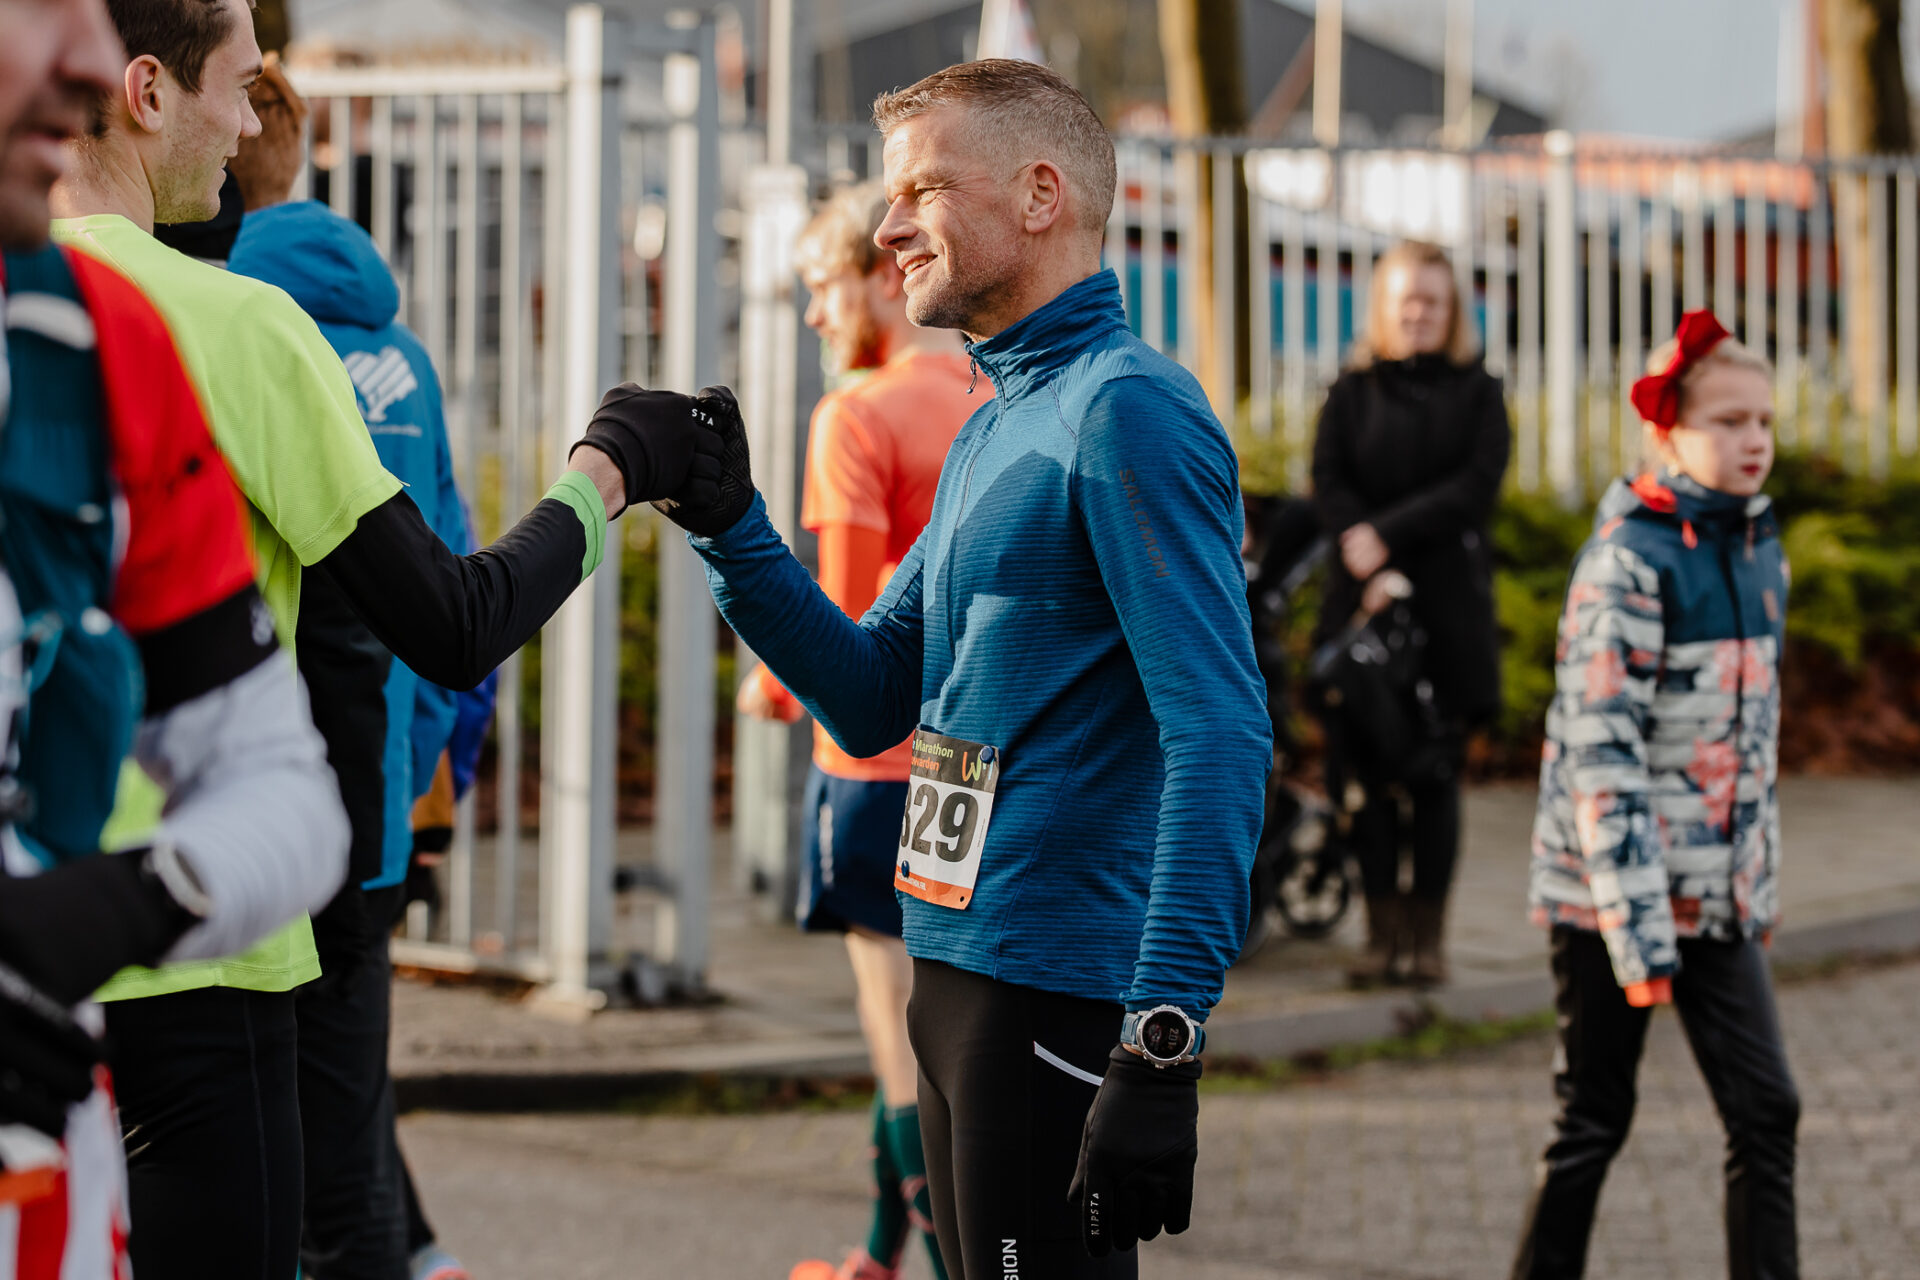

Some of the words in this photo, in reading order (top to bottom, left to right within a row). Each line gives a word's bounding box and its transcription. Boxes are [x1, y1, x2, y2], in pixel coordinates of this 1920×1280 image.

[691, 408, 714, 426] STA
[1119, 469, 1171, 578] SALOMON
[915, 738, 954, 758] Marathon
[1090, 1192, 1100, 1236] KIPSTA
